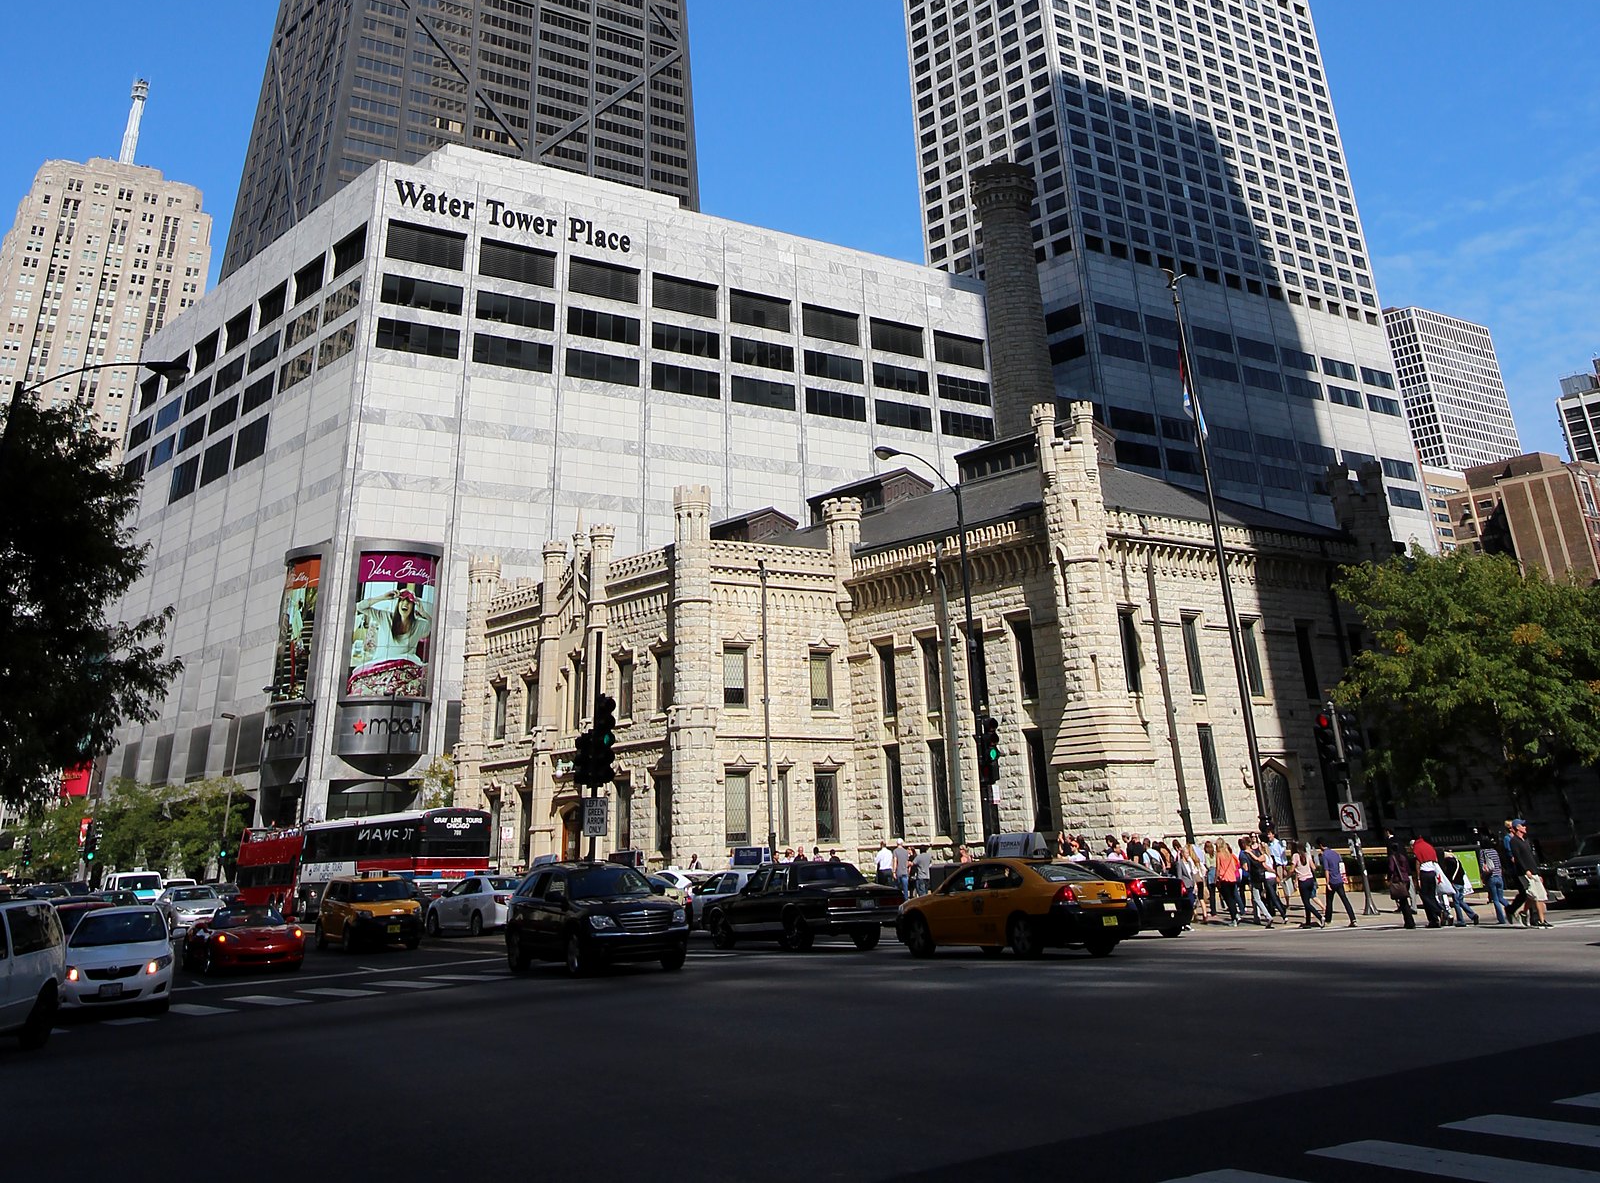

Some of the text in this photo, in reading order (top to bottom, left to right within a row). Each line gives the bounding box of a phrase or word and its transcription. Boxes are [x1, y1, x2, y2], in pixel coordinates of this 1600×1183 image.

[394, 179, 631, 252] Water Tower Place
[367, 555, 434, 585] Vera Bradley
[586, 800, 598, 808] LEFT
